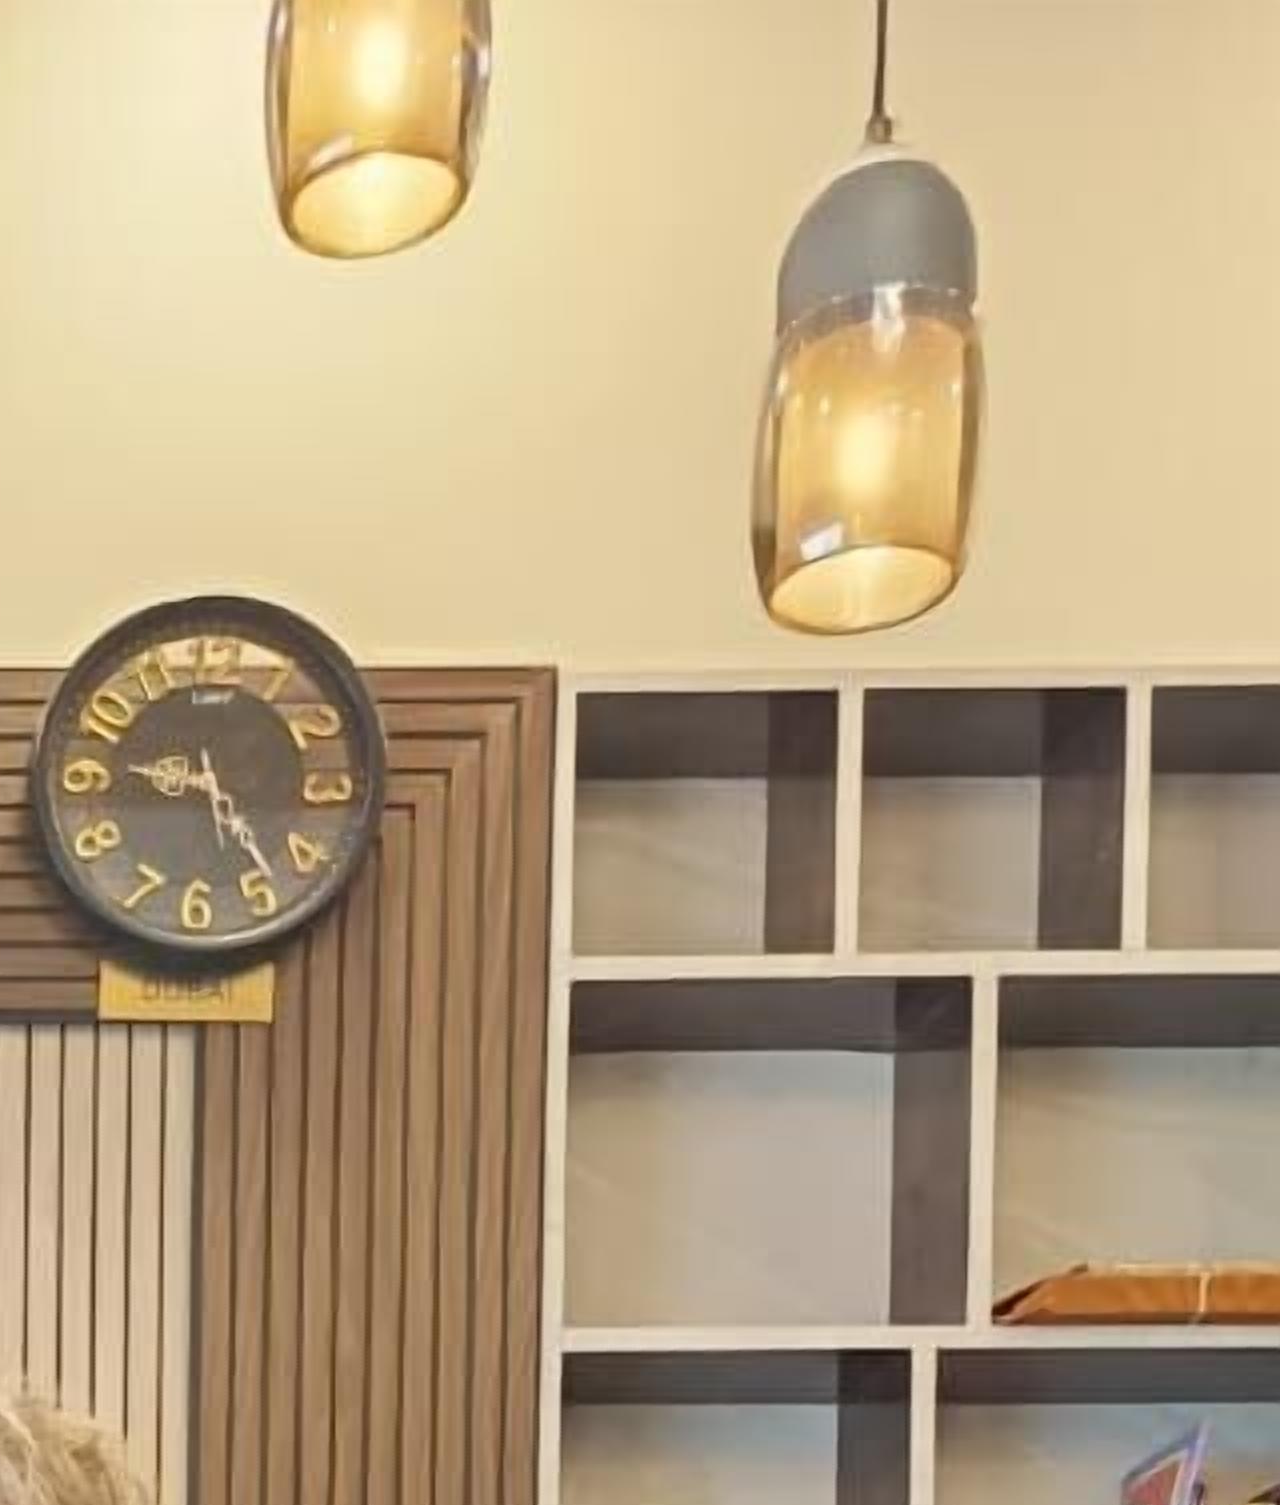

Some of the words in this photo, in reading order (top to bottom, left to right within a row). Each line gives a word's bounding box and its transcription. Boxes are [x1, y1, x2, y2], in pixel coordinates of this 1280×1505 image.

[128, 654, 171, 701] 11
[188, 640, 242, 685] 12
[264, 668, 290, 701] 1
[81, 690, 130, 743] 10
[288, 705, 341, 749] 2
[64, 760, 110, 792] 9
[304, 772, 352, 802] 3
[76, 820, 120, 858] 8
[288, 832, 329, 871] 4
[116, 863, 165, 907] 7
[181, 879, 211, 929] 6
[240, 871, 277, 915] 5
